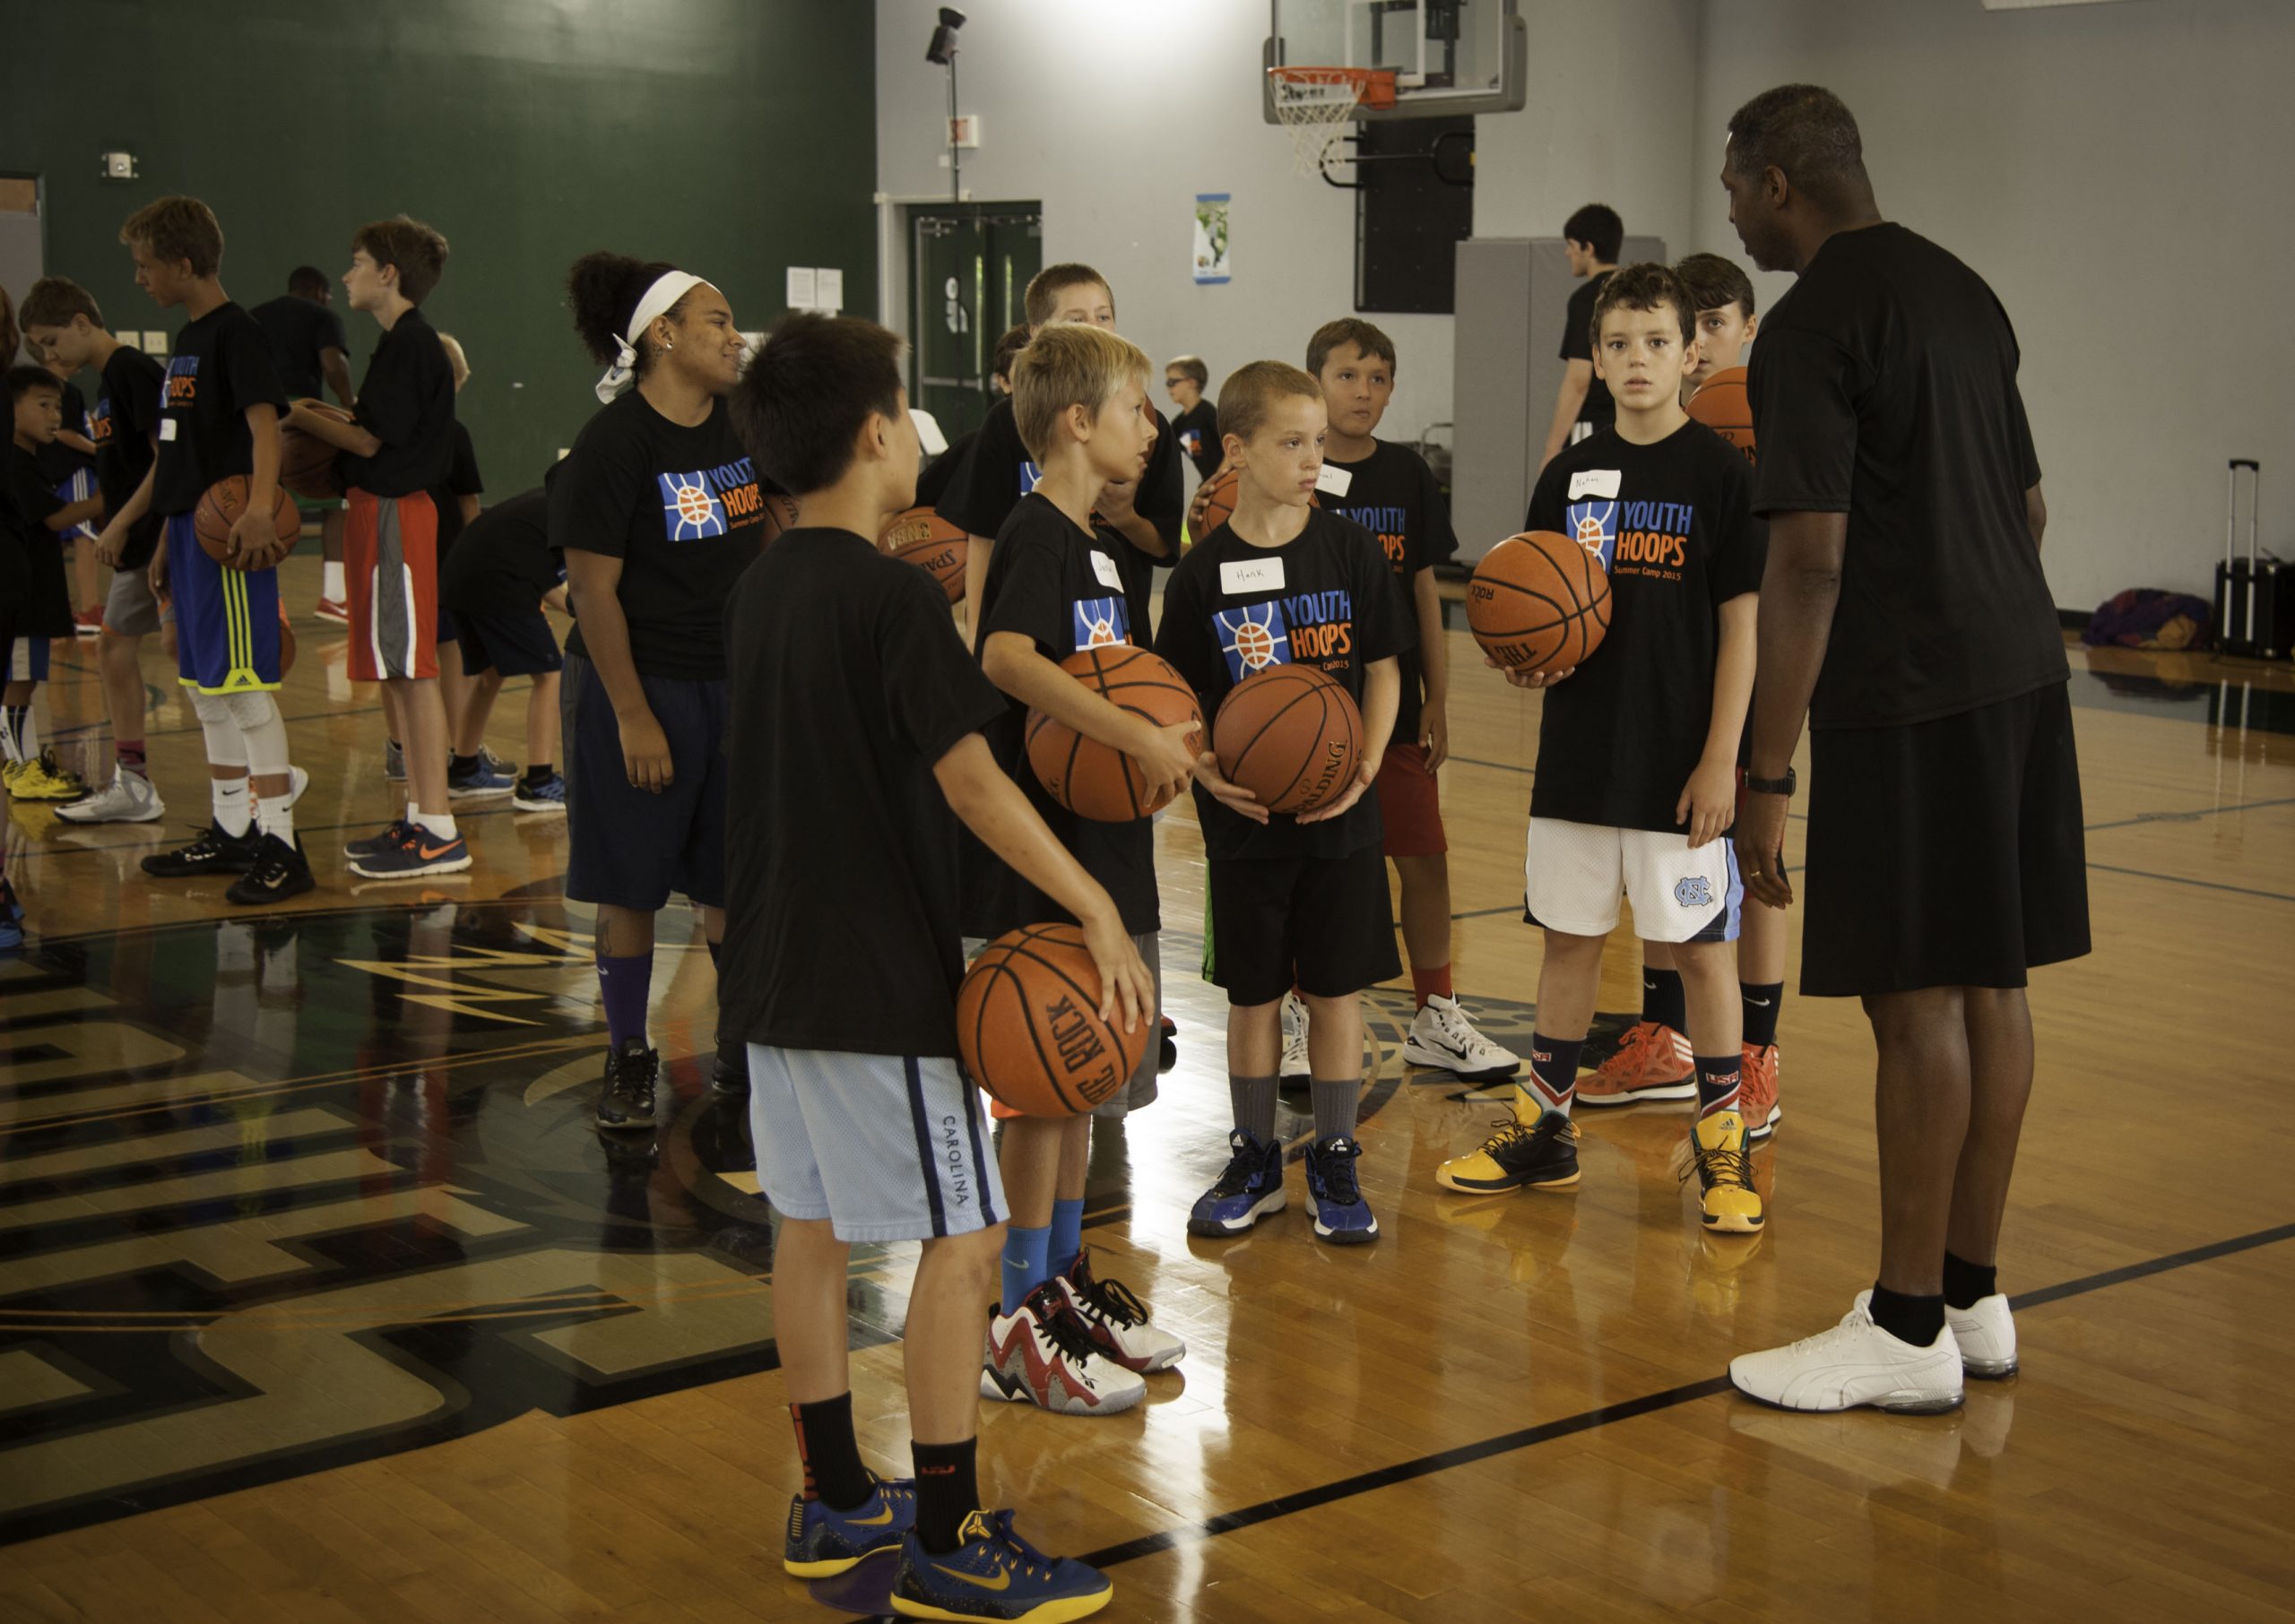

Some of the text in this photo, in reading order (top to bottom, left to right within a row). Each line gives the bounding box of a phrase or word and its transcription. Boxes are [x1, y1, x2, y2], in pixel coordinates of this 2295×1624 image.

[1624, 501, 1693, 534] YOUTH
[1615, 531, 1687, 567] HOOPS
[1235, 566, 1266, 582] Hank
[1614, 566, 1682, 581] Summer Camp 2015
[1284, 590, 1352, 626] YOUTH
[1290, 622, 1352, 659] HOOPS
[1046, 994, 1105, 1074] ROCK
[943, 1115, 970, 1205] CAROLINA
